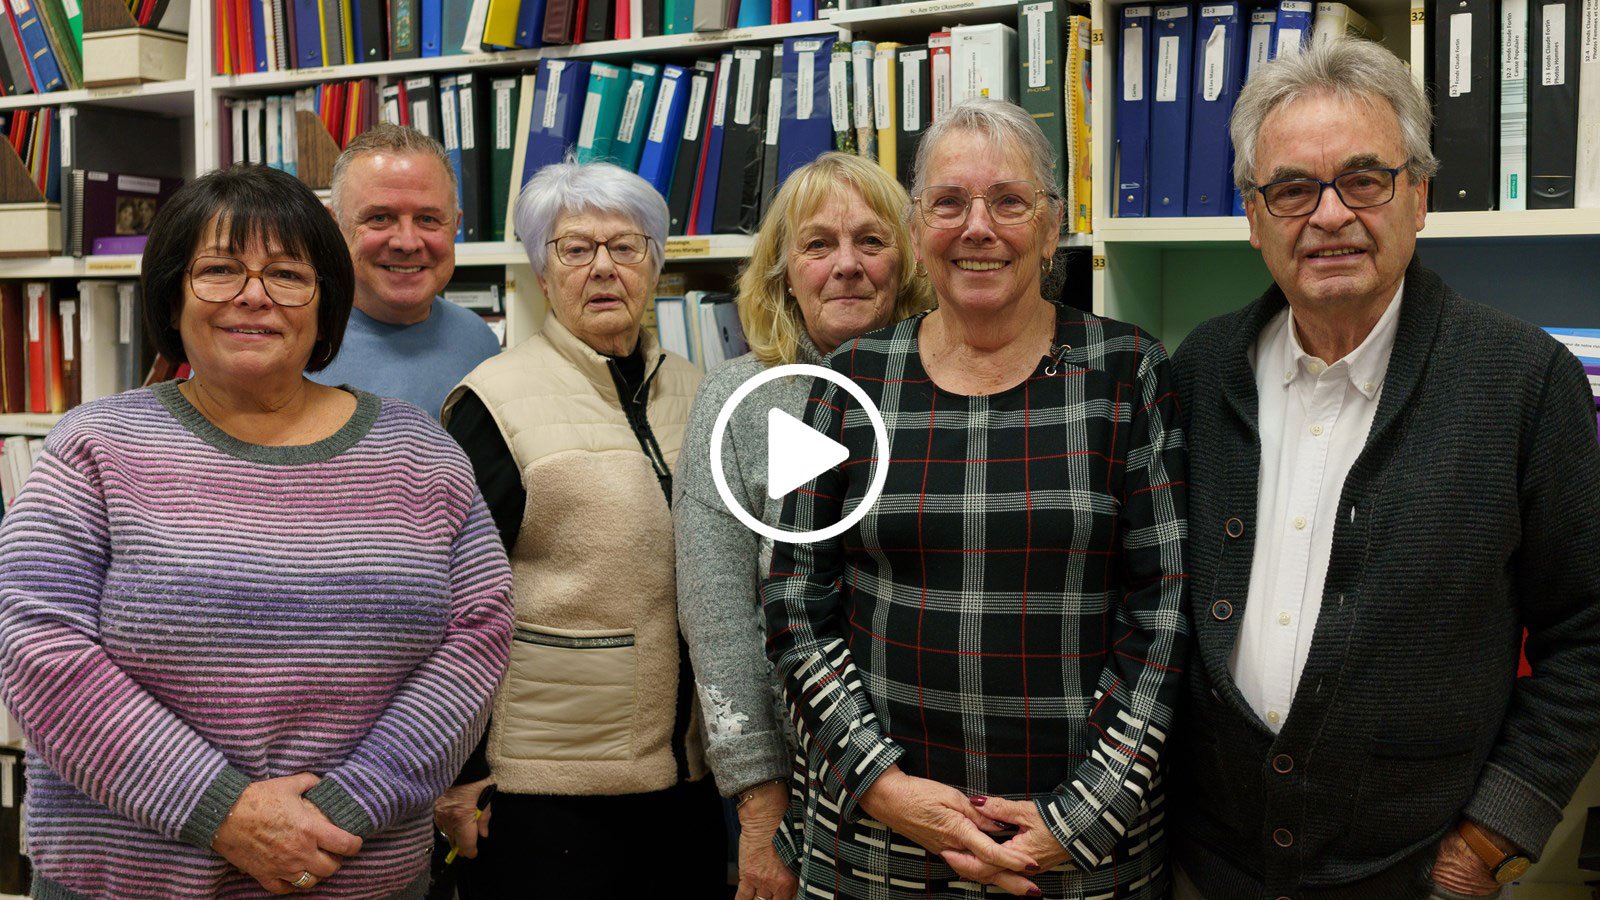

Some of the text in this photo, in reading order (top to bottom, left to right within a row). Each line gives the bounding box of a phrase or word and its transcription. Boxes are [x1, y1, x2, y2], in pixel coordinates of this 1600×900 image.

[1411, 12, 1425, 22] 32
[1092, 33, 1104, 42] 31
[1093, 258, 1106, 268] 33
